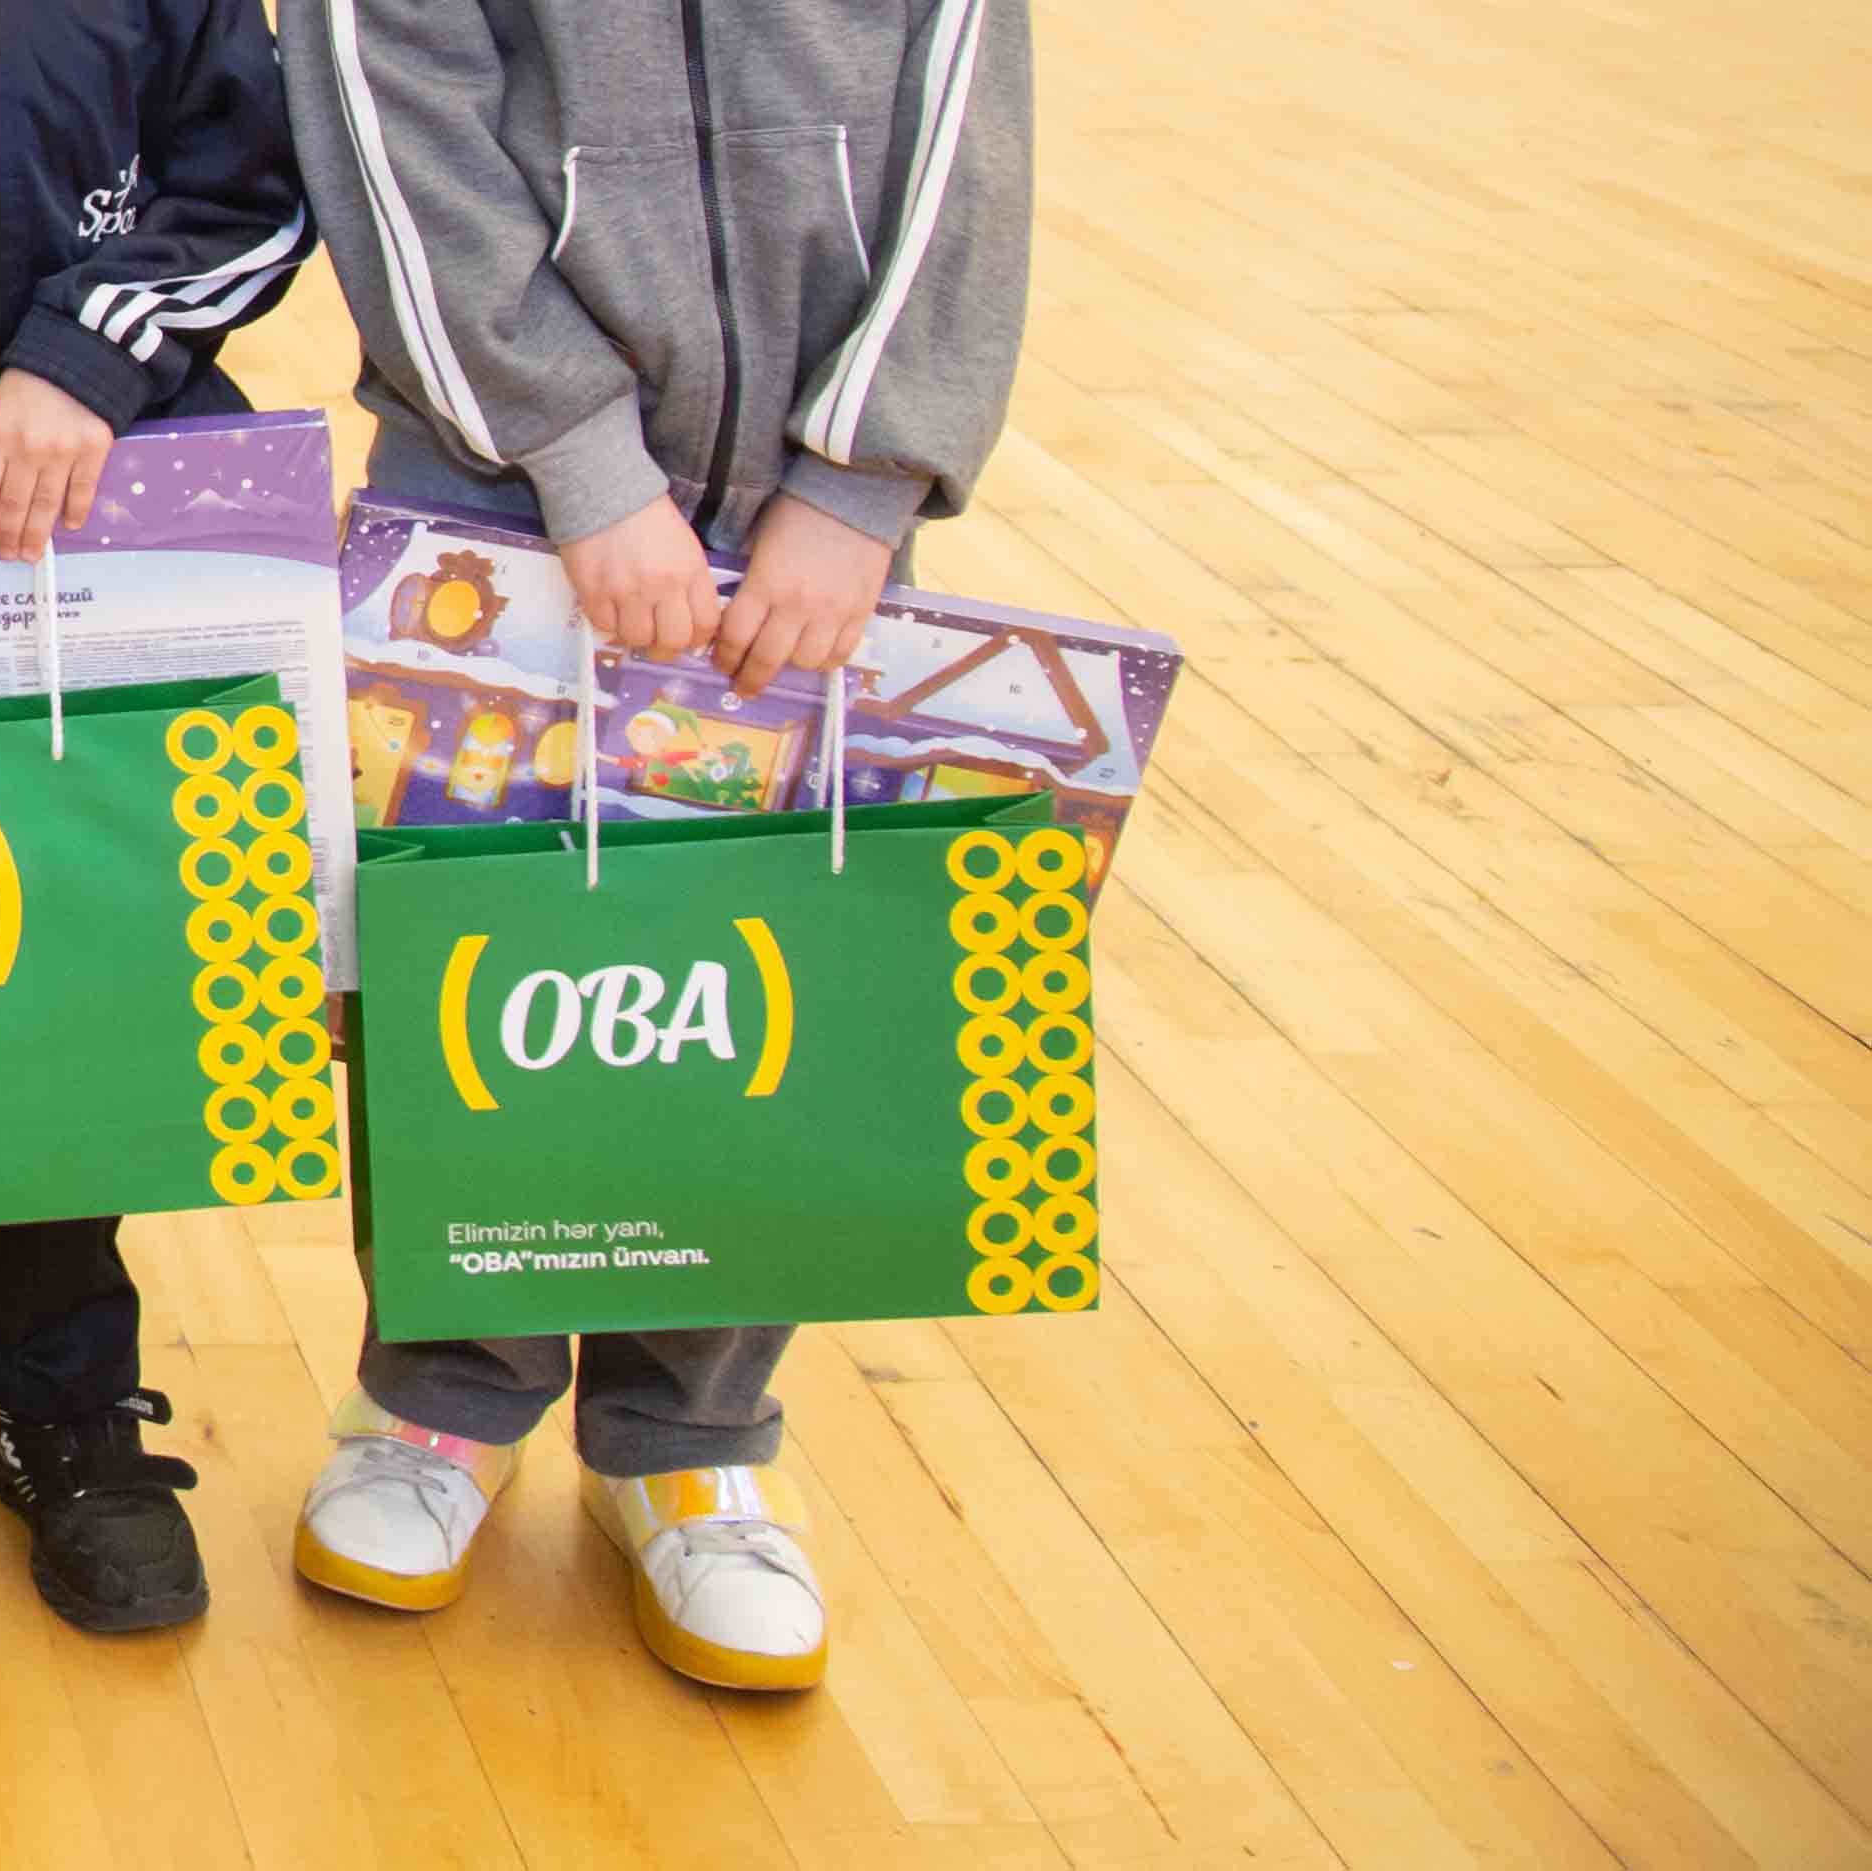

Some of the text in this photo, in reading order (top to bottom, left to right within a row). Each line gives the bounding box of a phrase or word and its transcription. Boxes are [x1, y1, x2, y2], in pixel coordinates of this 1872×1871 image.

[14, 587, 95, 606] слкий
[447, 1219, 666, 1244] Elimizin hər yanı,
[612, 1245, 711, 1268] ünvanı.
